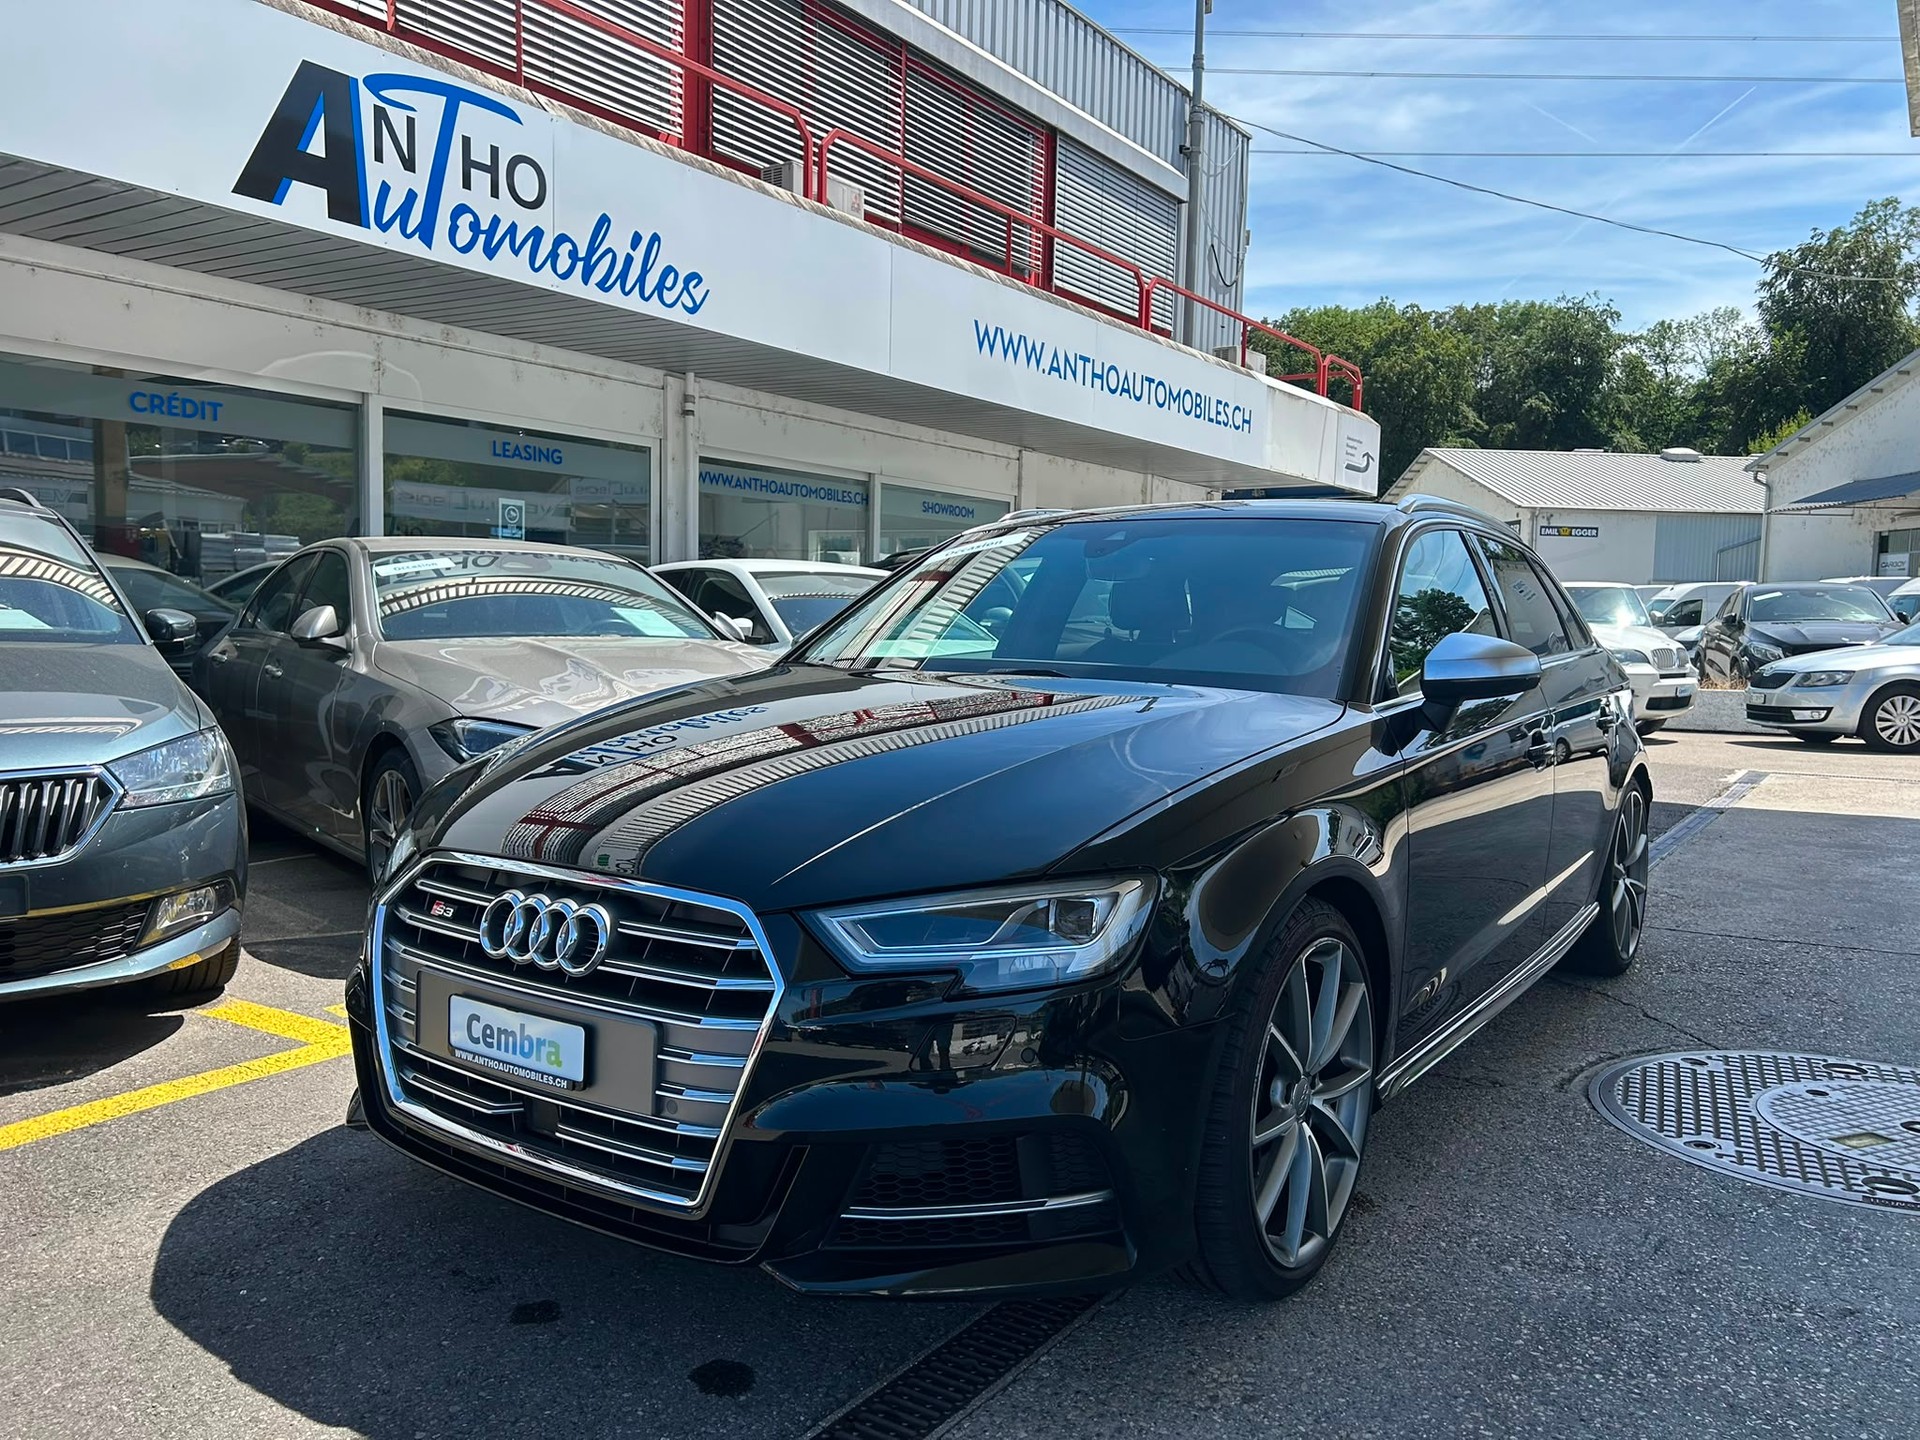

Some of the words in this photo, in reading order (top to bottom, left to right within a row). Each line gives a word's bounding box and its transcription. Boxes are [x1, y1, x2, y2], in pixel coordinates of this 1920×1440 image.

[231, 59, 547, 250] ANTHO
[973, 319, 1252, 434] WWW.ANTHOAUTOMOBILES.CH
[129, 391, 224, 421] CRÉDIT
[493, 440, 563, 465] LEASING
[699, 471, 869, 505] WWW.ANTHOAUTOMOBILES.CH
[922, 501, 975, 518] SHOWROOM
[432, 902, 454, 917] S3
[467, 1013, 562, 1068] Cembra
[454, 1049, 567, 1089] WWW.ANTHOAUTOMOBILES.CH
